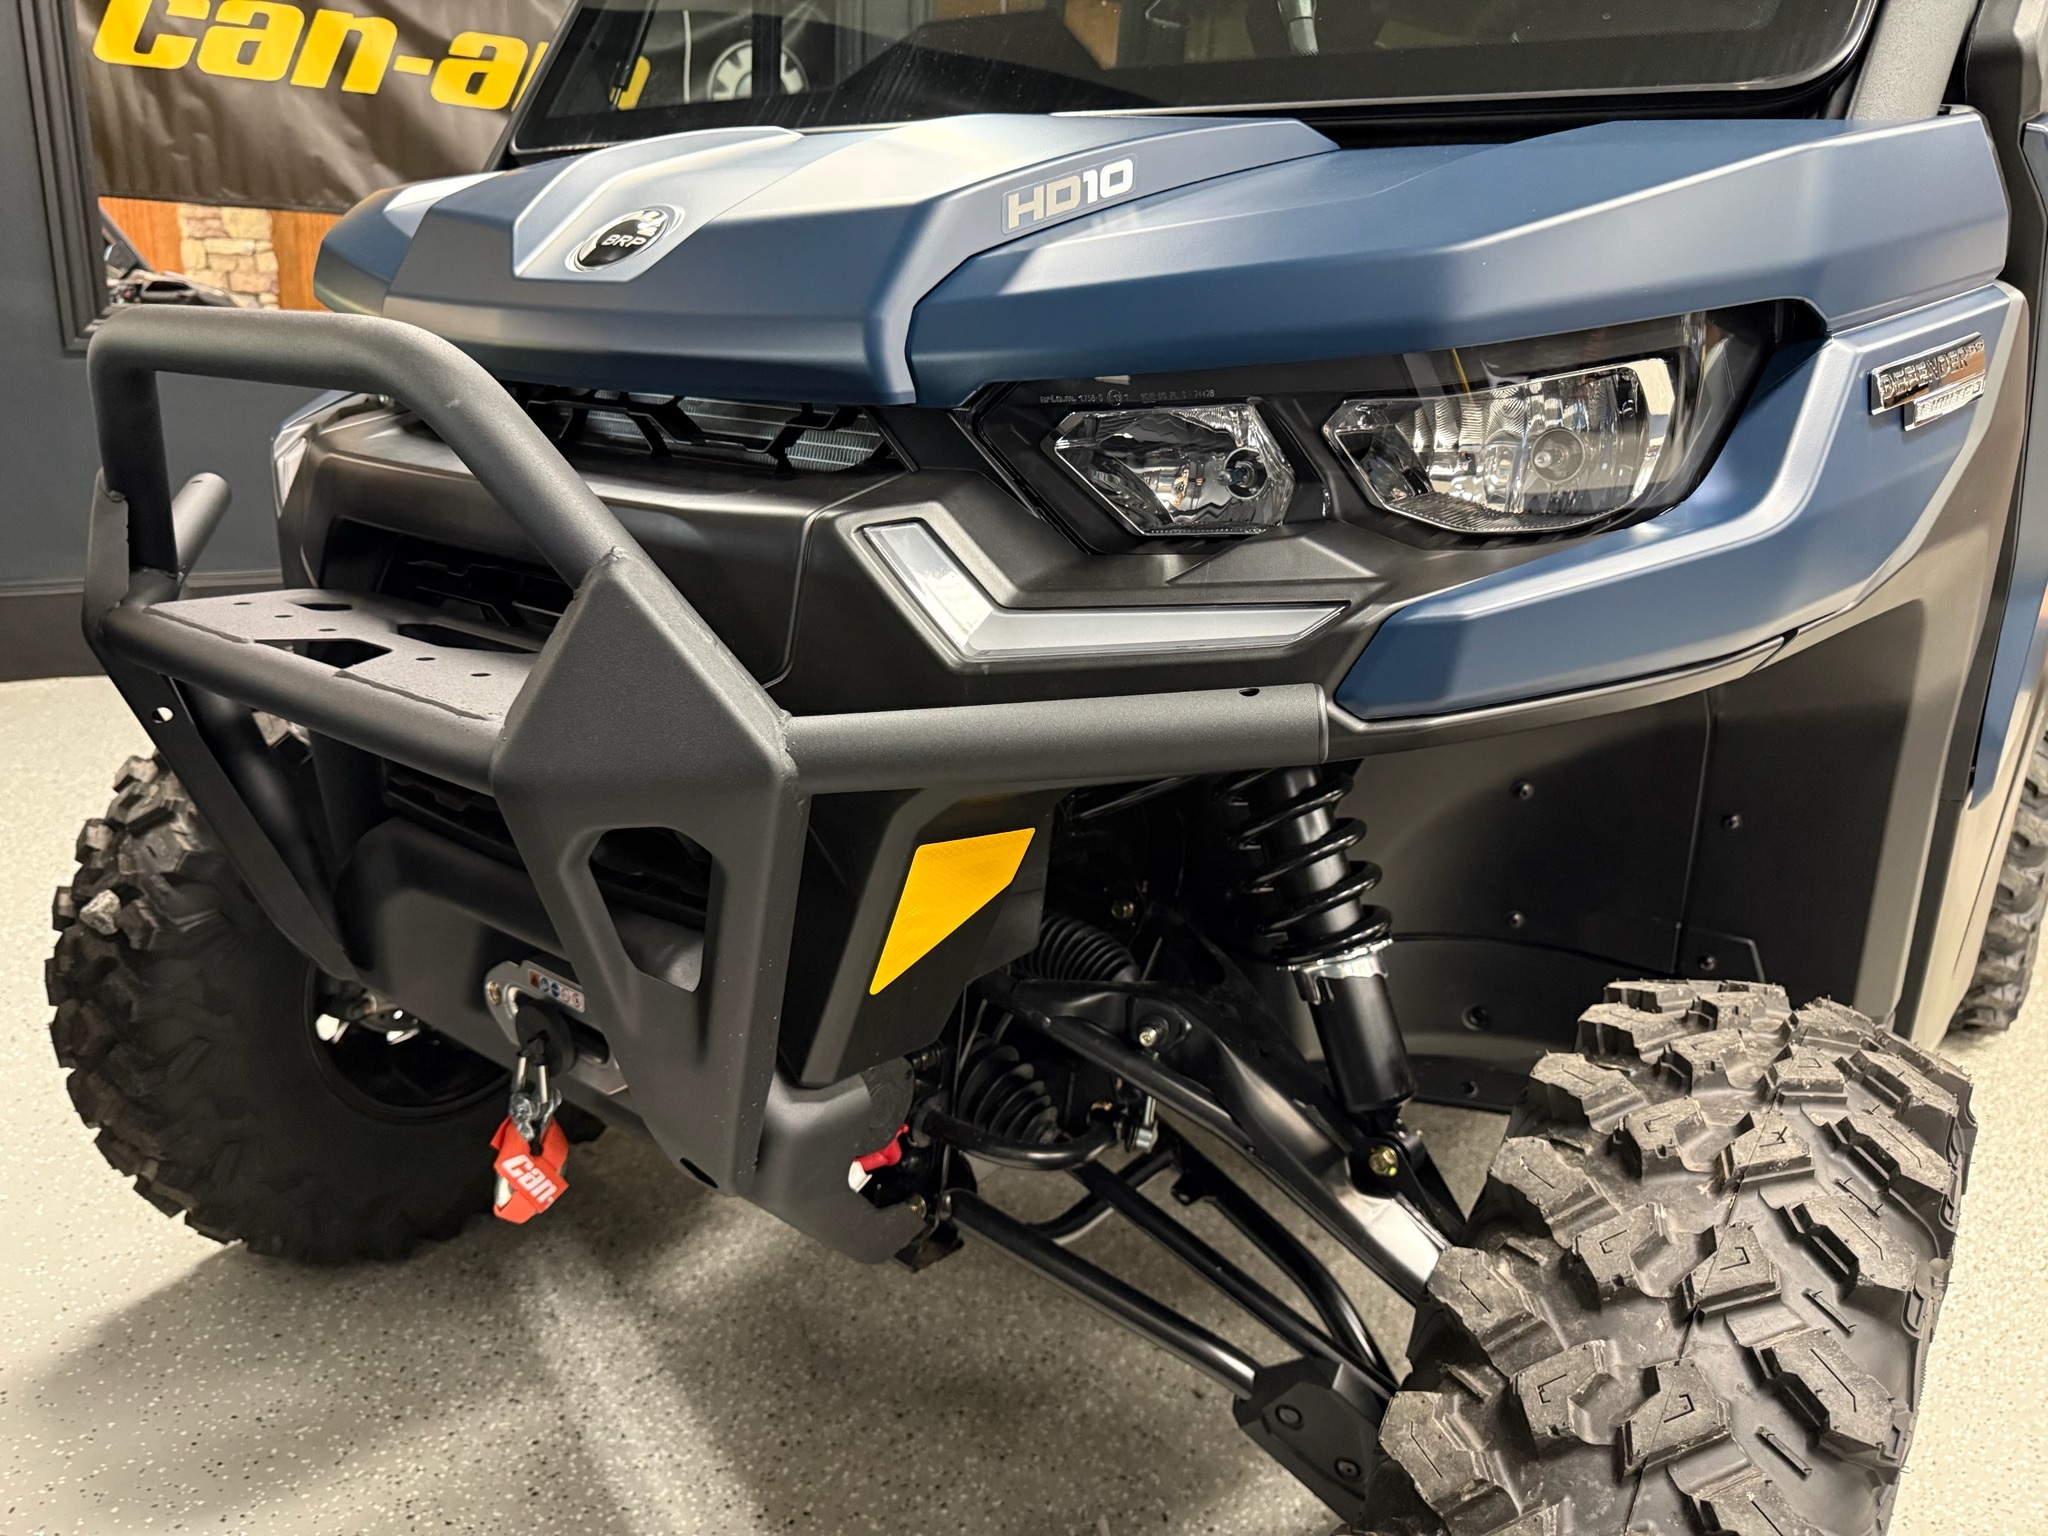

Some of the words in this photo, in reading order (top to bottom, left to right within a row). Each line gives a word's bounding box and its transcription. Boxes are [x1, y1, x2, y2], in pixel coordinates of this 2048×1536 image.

[92, 0, 549, 111] can-a
[1008, 158, 1134, 230] HD10
[600, 233, 647, 249] BRP
[1880, 347, 1969, 401] DEFENDER
